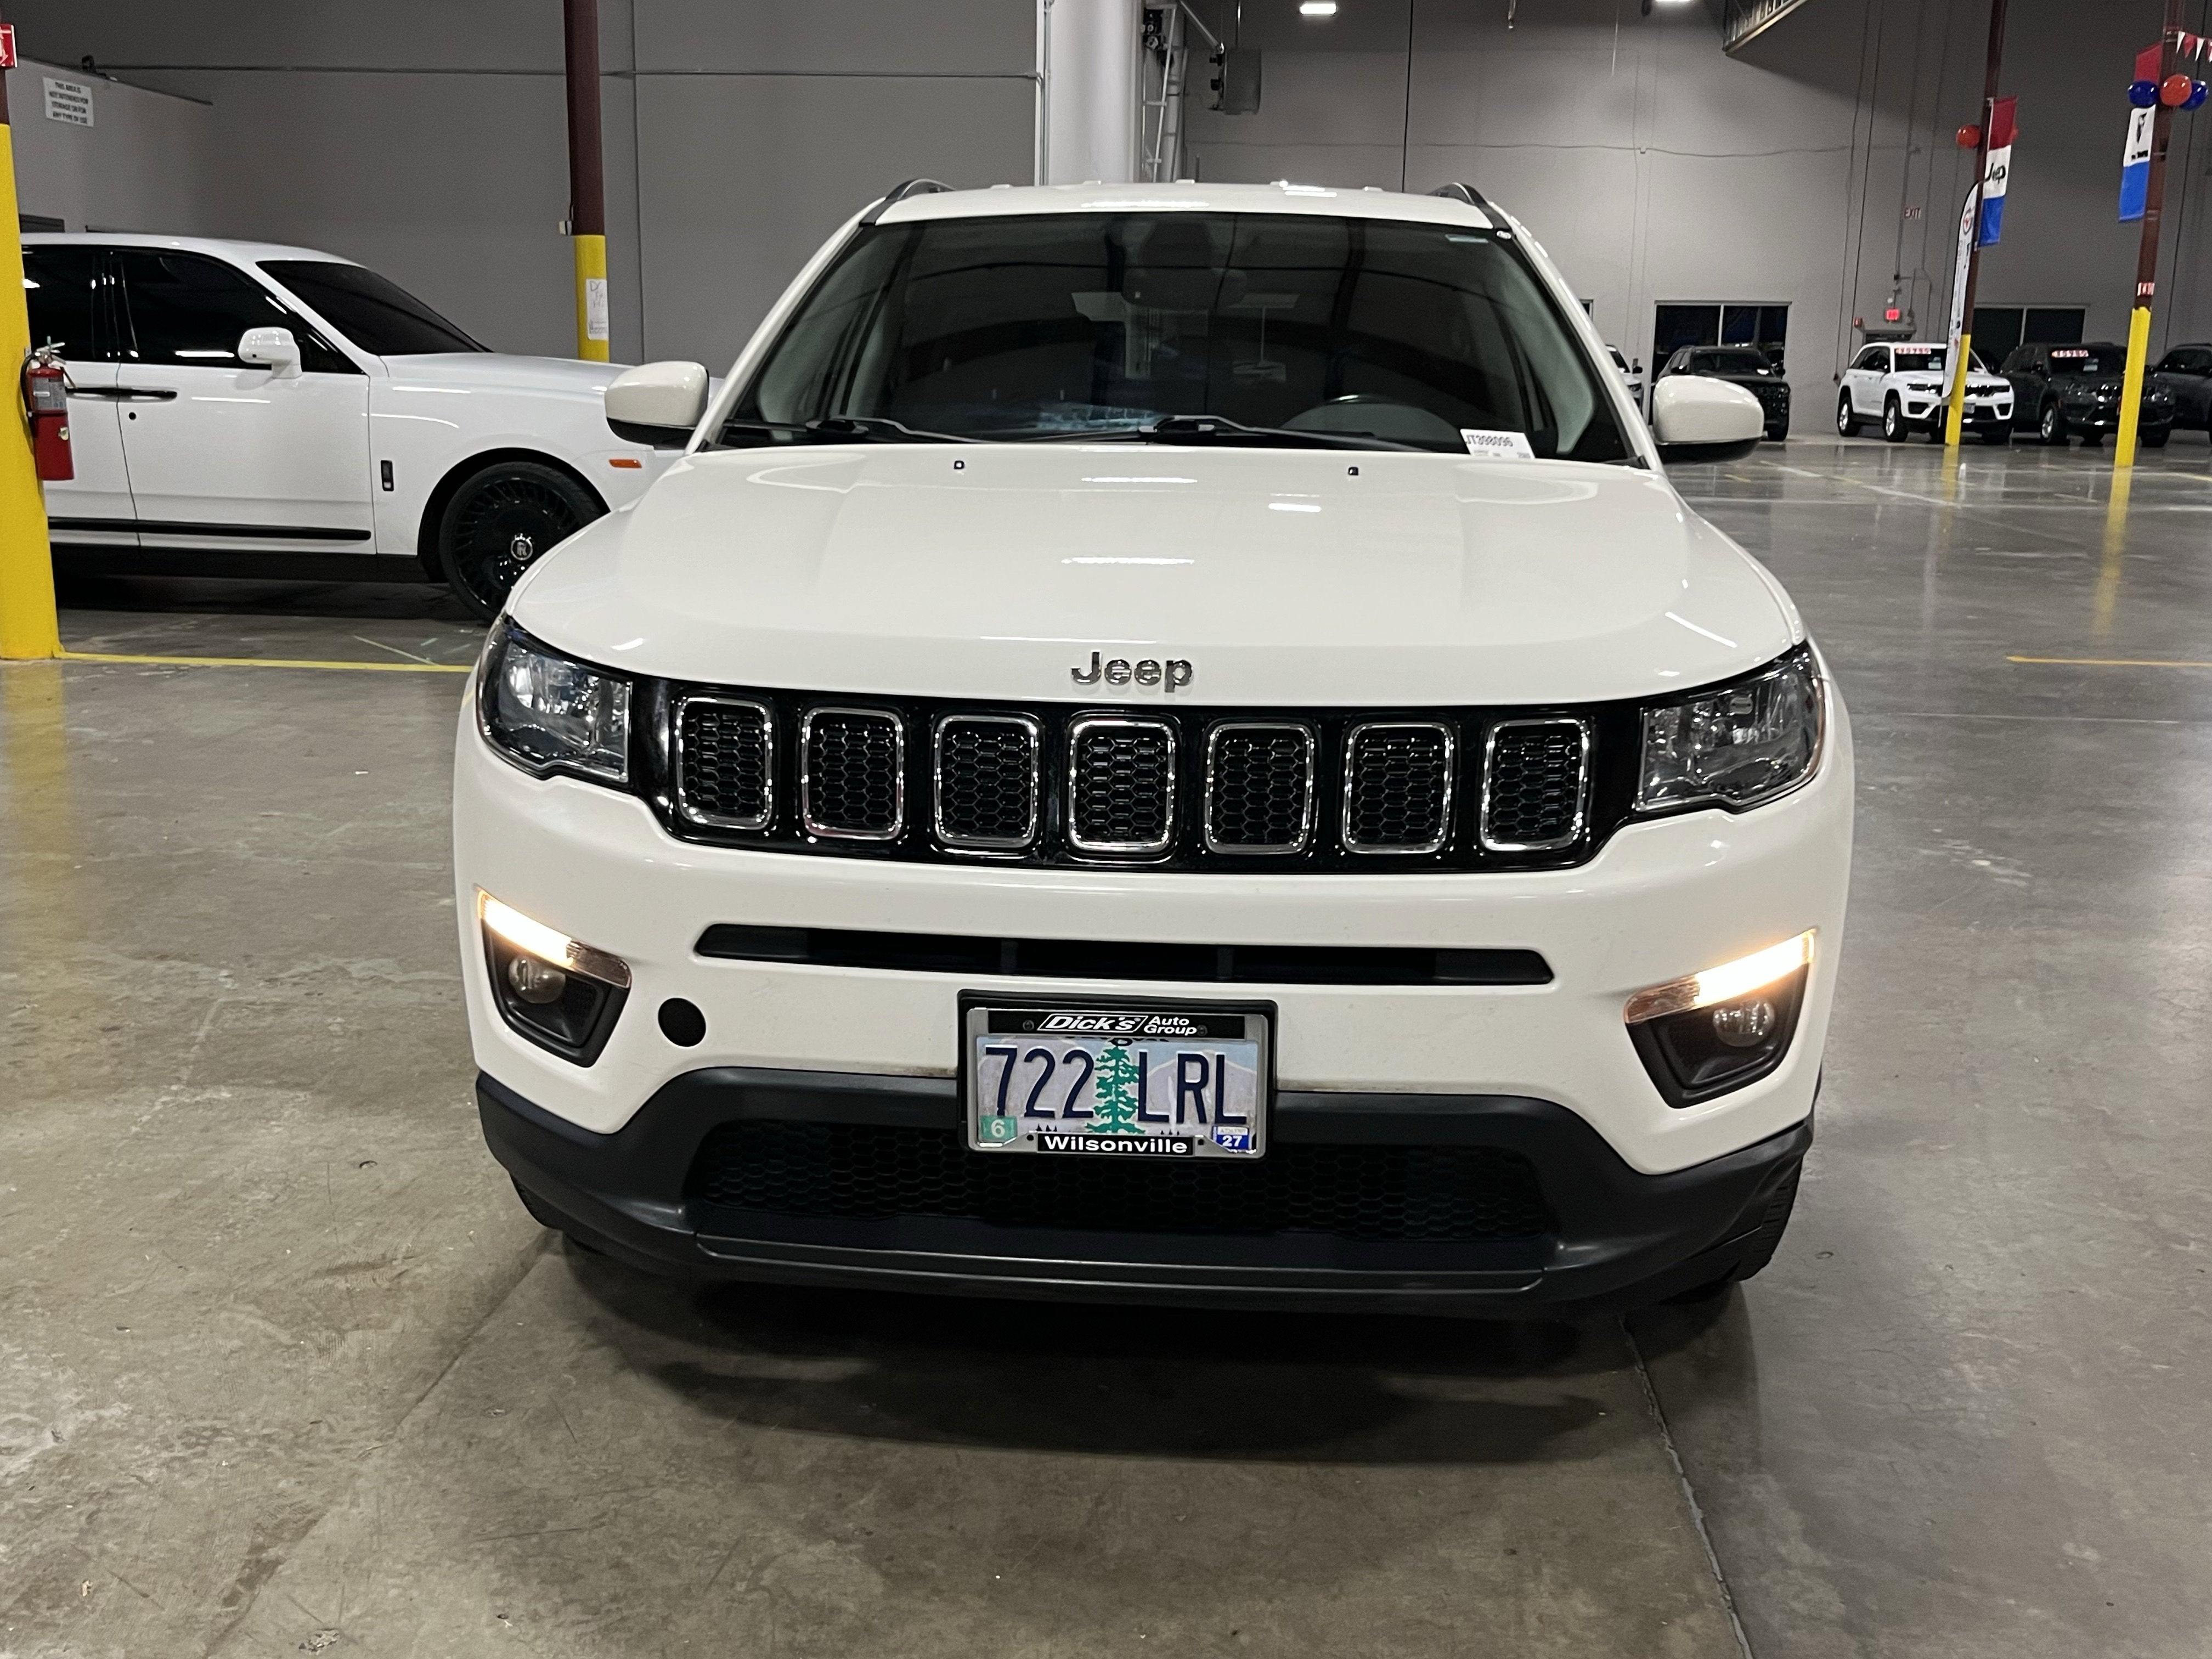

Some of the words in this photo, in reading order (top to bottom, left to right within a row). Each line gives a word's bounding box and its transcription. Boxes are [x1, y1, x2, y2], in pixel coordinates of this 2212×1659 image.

[1904, 207, 1921, 219] EXIT
[1071, 651, 1194, 693] Jeep
[1045, 1015, 1136, 1031] Dick's
[1148, 1015, 1189, 1026] Auto
[1143, 1025, 1197, 1036] Group
[985, 1046, 1094, 1118] 722
[1138, 1051, 1247, 1125] LRL
[991, 1119, 1005, 1138] 6
[1044, 1136, 1188, 1153] Wilsonville
[1222, 1135, 1243, 1147] 27
